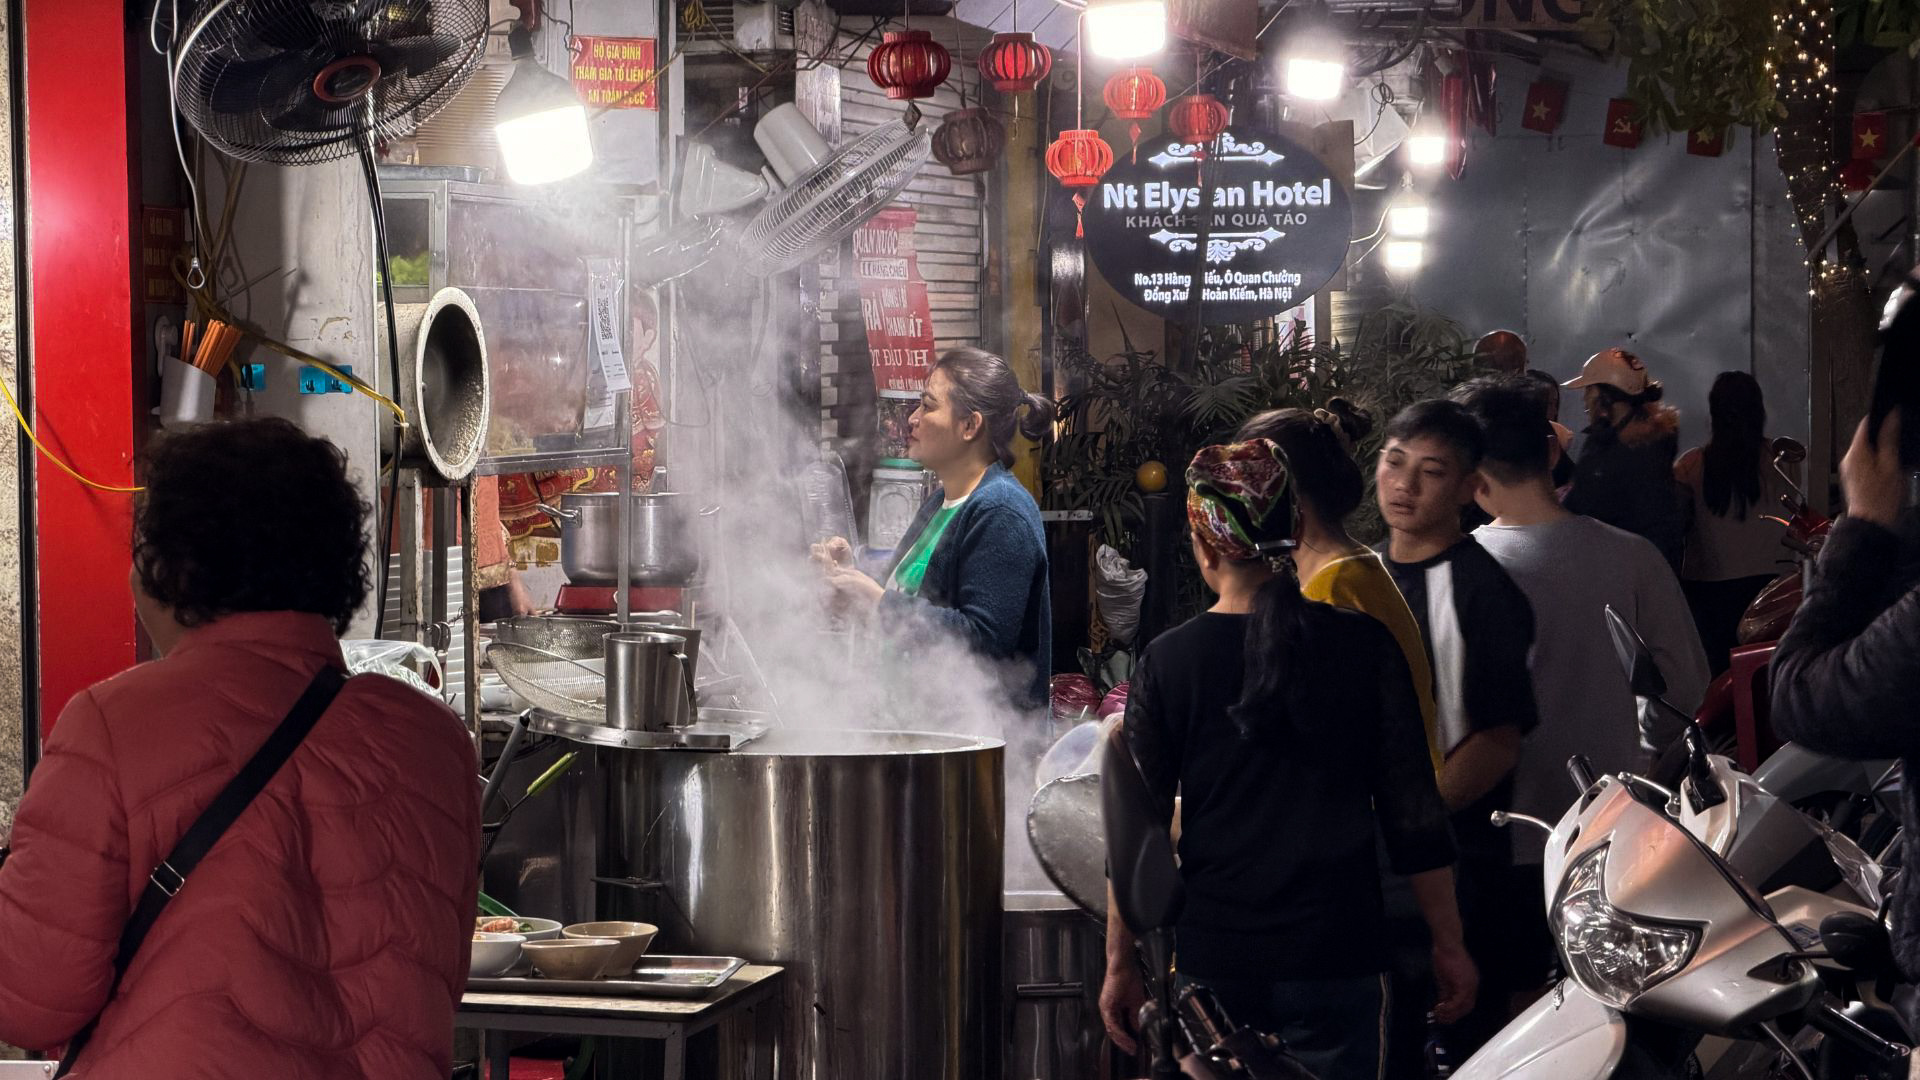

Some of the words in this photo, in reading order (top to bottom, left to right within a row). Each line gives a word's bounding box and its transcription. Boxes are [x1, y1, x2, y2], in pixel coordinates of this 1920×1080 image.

[606, 44, 620, 60] GIA
[1103, 183, 1138, 209] Nt
[1144, 181, 1245, 215] Elysan
[1252, 178, 1331, 206] Hotel
[1126, 211, 1186, 229] KHÁCH
[1272, 212, 1308, 226] TÁO
[1134, 273, 1163, 285] No.13
[1164, 272, 1192, 287] Hàng
[1224, 269, 1234, 284] Ô
[1235, 272, 1261, 286] Quan
[1258, 287, 1273, 300] Hà
[1274, 287, 1292, 303] Nội
